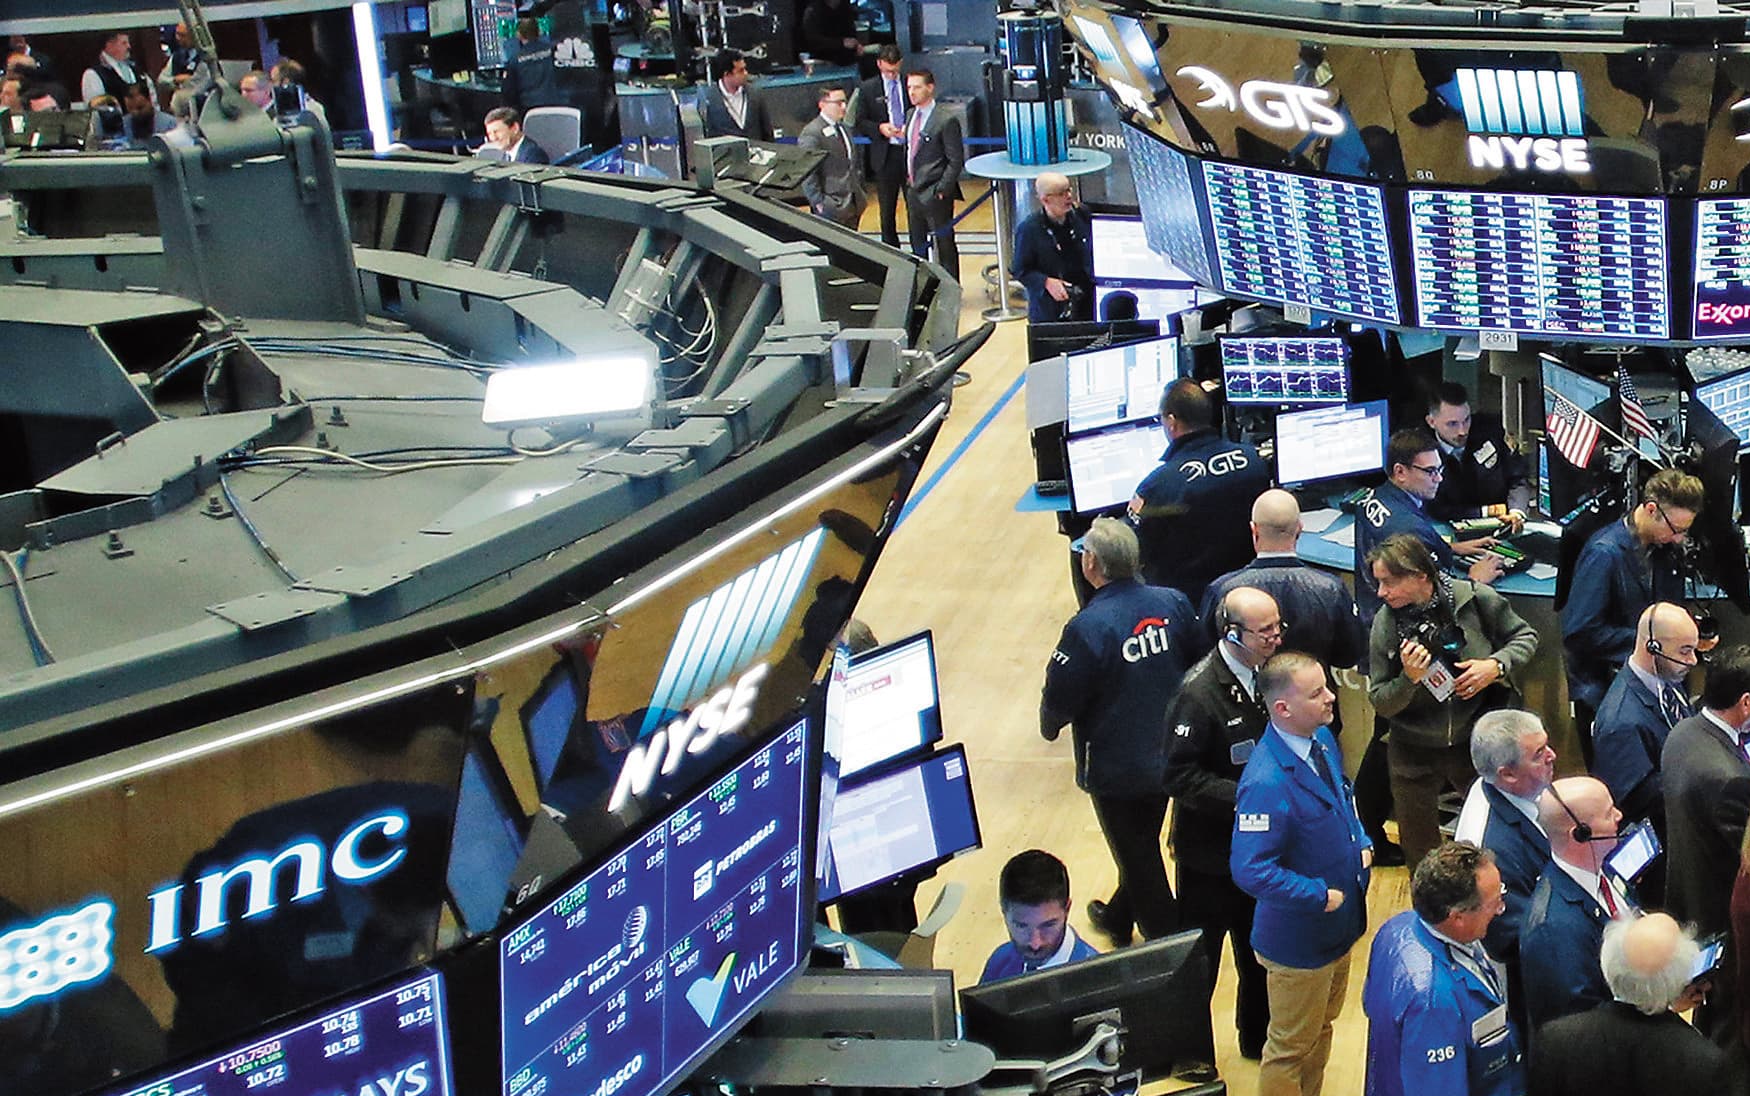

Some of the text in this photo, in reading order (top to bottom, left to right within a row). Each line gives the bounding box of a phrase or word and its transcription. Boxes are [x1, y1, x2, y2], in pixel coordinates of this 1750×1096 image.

[553, 58, 596, 67] CNBC
[1242, 80, 1345, 134] GTS
[1468, 136, 1590, 171] NYSE
[1709, 180, 1727, 190] 8P
[1486, 332, 1512, 343] 2931
[1209, 448, 1249, 475] GTS
[1366, 493, 1391, 528] GTS
[1122, 618, 1170, 663] citi
[608, 662, 768, 812] NYSE
[671, 809, 689, 831] PBR
[716, 819, 776, 876] PETROBRAS
[144, 814, 407, 954] imc
[516, 875, 542, 905] 6Q
[508, 925, 531, 952] AMX
[669, 937, 691, 962] VALE
[589, 942, 645, 995] móvil
[734, 941, 778, 994] VALE
[396, 983, 431, 1005] 10.75
[525, 943, 622, 1026] américa
[322, 1012, 358, 1034] 10.74
[398, 1007, 432, 1028] 10.71
[229, 1041, 281, 1071] 10.7500
[324, 1035, 360, 1058] 10.78
[1427, 1046, 1455, 1064] 236
[247, 1065, 284, 1088] 10.72
[510, 1068, 531, 1093] BBD
